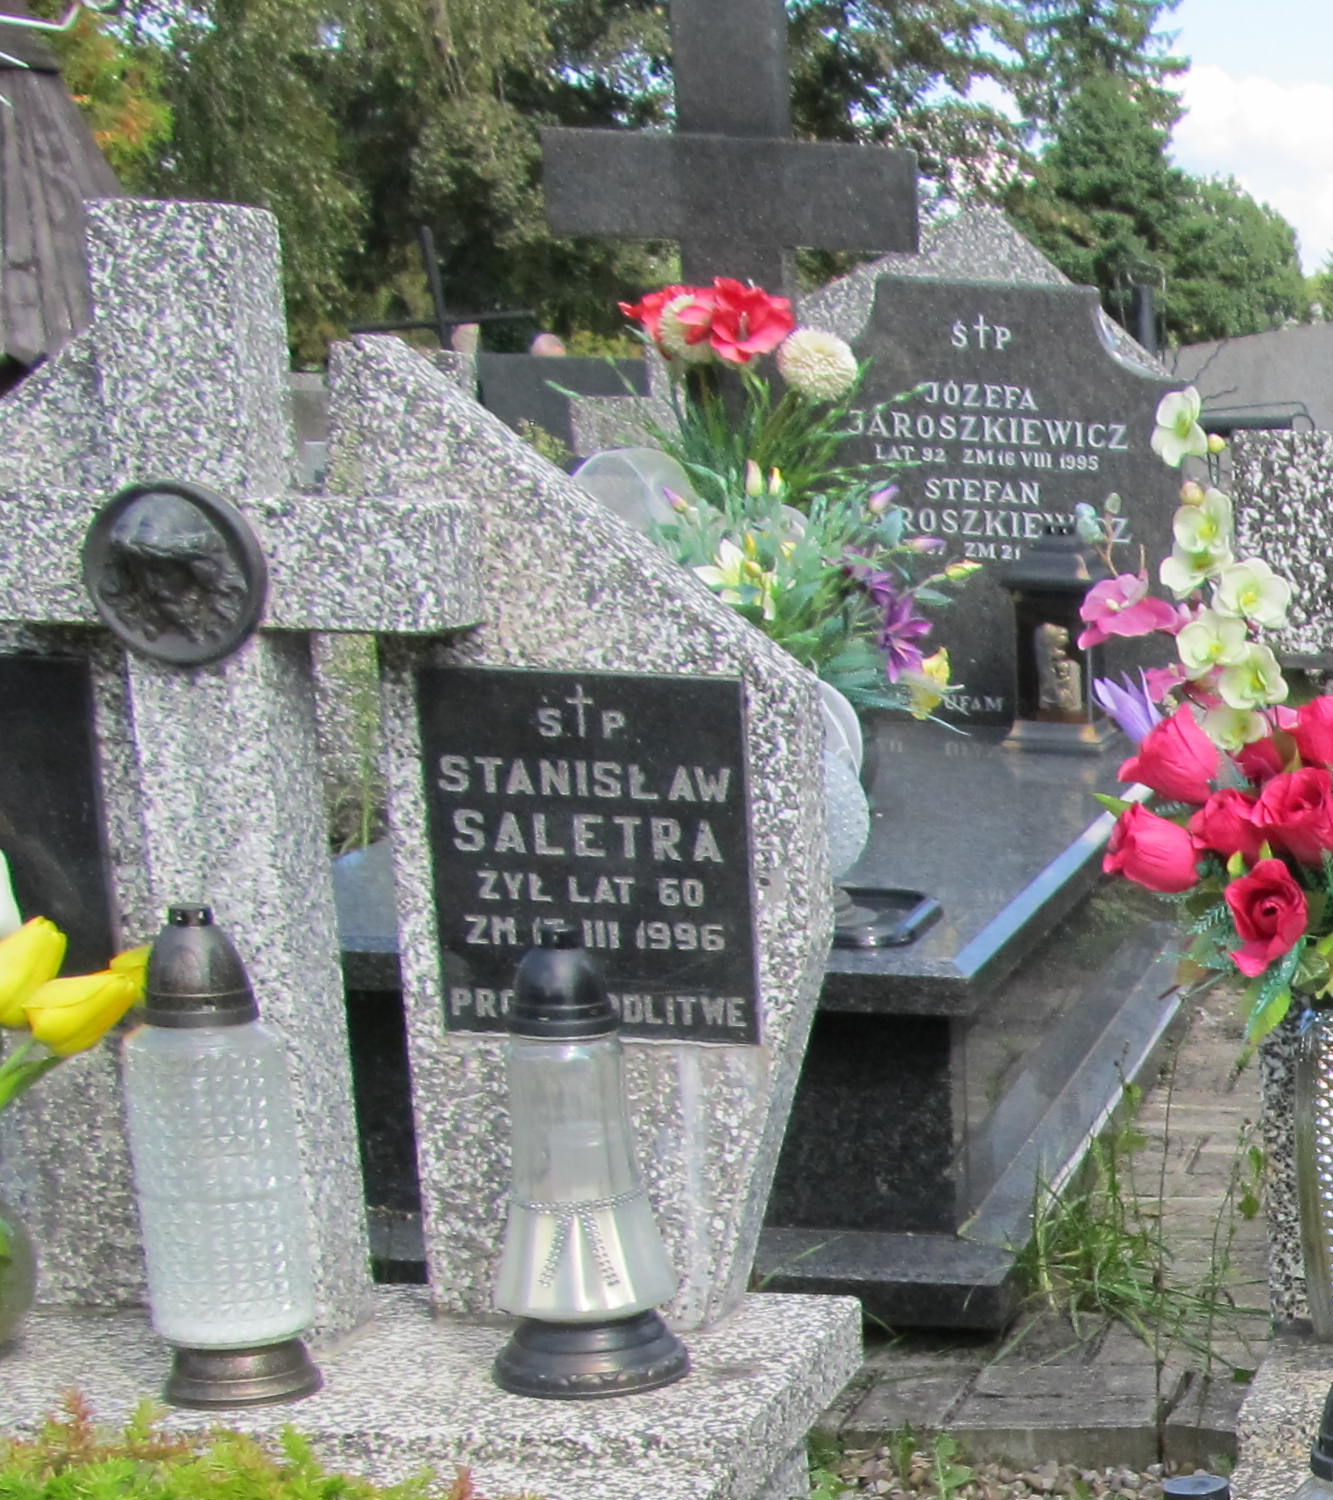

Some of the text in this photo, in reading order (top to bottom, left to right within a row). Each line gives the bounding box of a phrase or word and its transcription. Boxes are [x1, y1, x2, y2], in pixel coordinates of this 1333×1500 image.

[923, 379, 1039, 411] JÓZEFA
[848, 409, 1129, 450] JAROSZKIEWICZ
[873, 443, 914, 461] LAT
[1059, 453, 1099, 471] 1995
[924, 477, 1040, 505] STEFAN
[437, 754, 732, 803] STANISŁAW
[451, 808, 724, 864] SALETRA
[567, 875, 636, 904] LAT
[656, 877, 705, 908] 60
[581, 918, 621, 949] III
[635, 921, 726, 951] 1996
